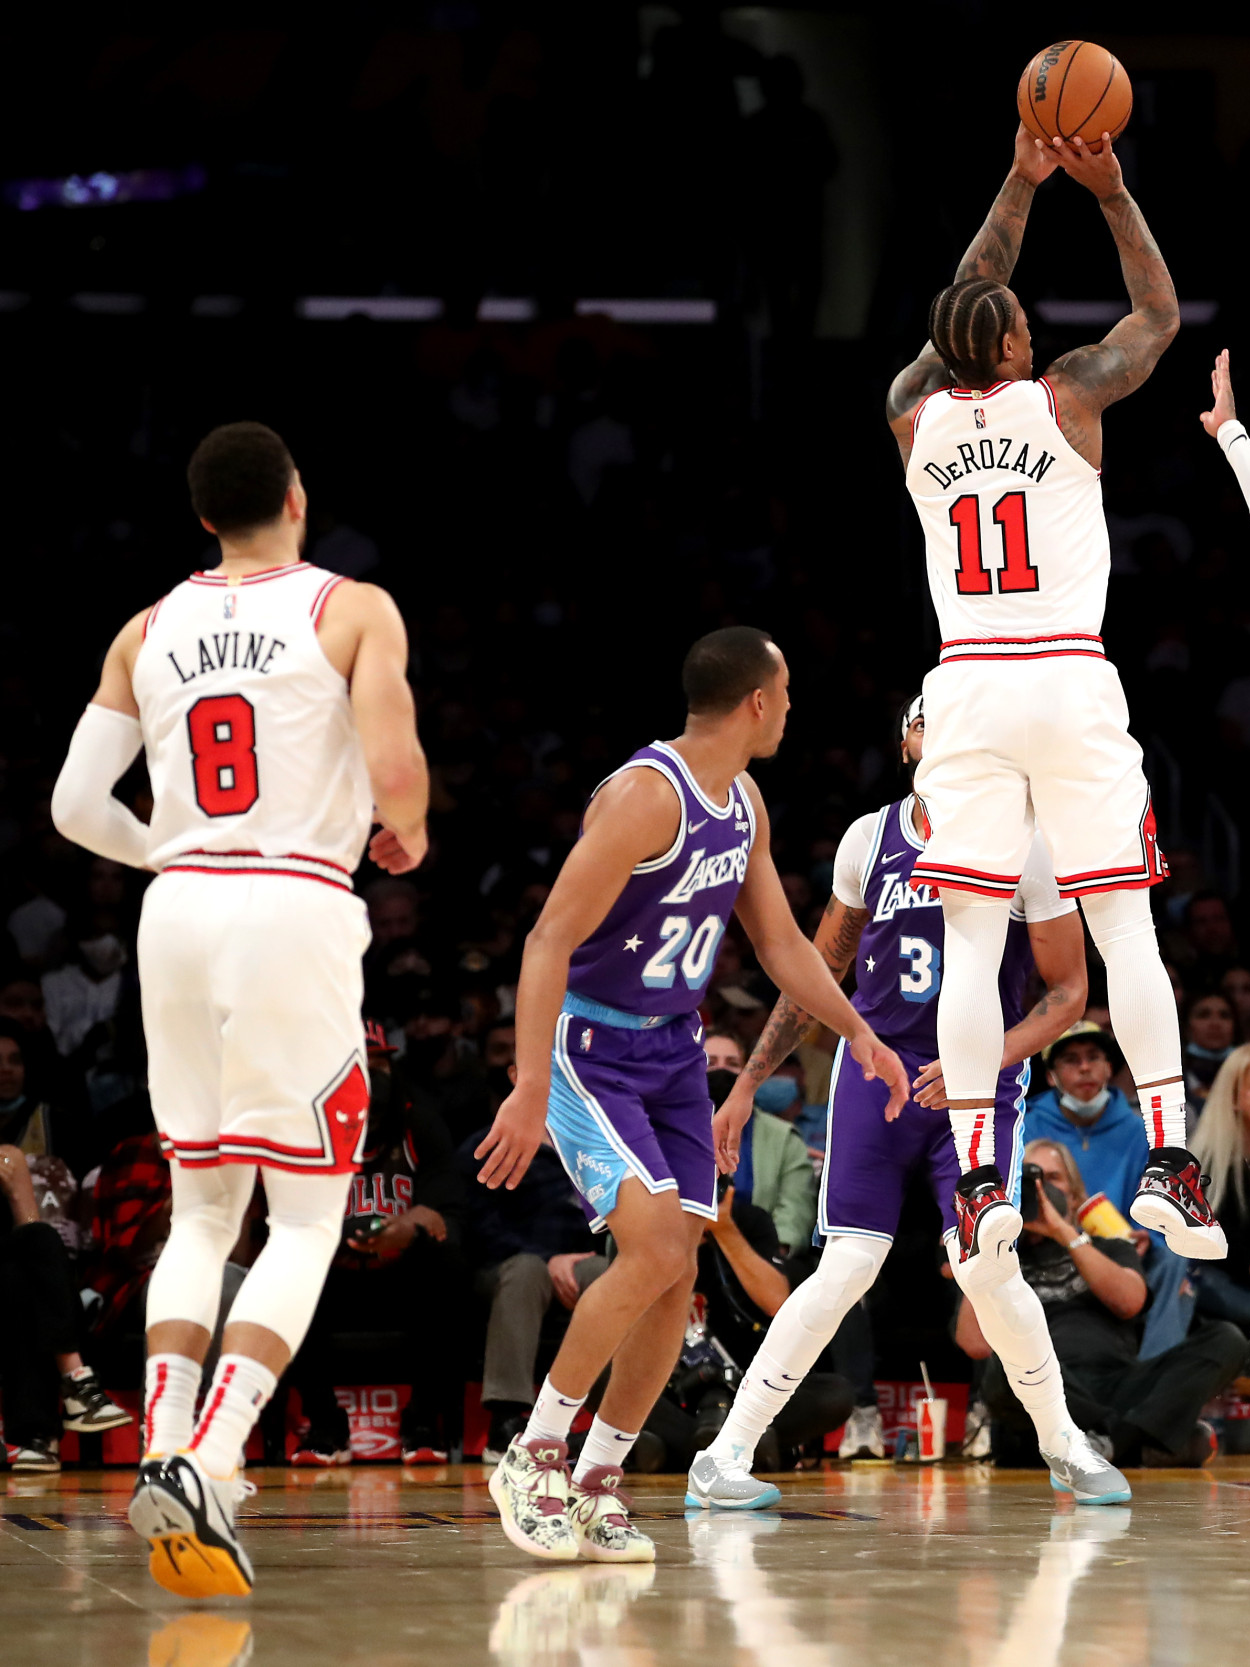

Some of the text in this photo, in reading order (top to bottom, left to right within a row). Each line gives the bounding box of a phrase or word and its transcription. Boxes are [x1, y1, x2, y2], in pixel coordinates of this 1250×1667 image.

[949, 491, 1039, 595] 11
[167, 631, 286, 684] LAVINE
[187, 693, 260, 818] 8
[658, 838, 750, 904] LAKERS
[641, 914, 726, 990] 20
[899, 934, 941, 1003] 3
